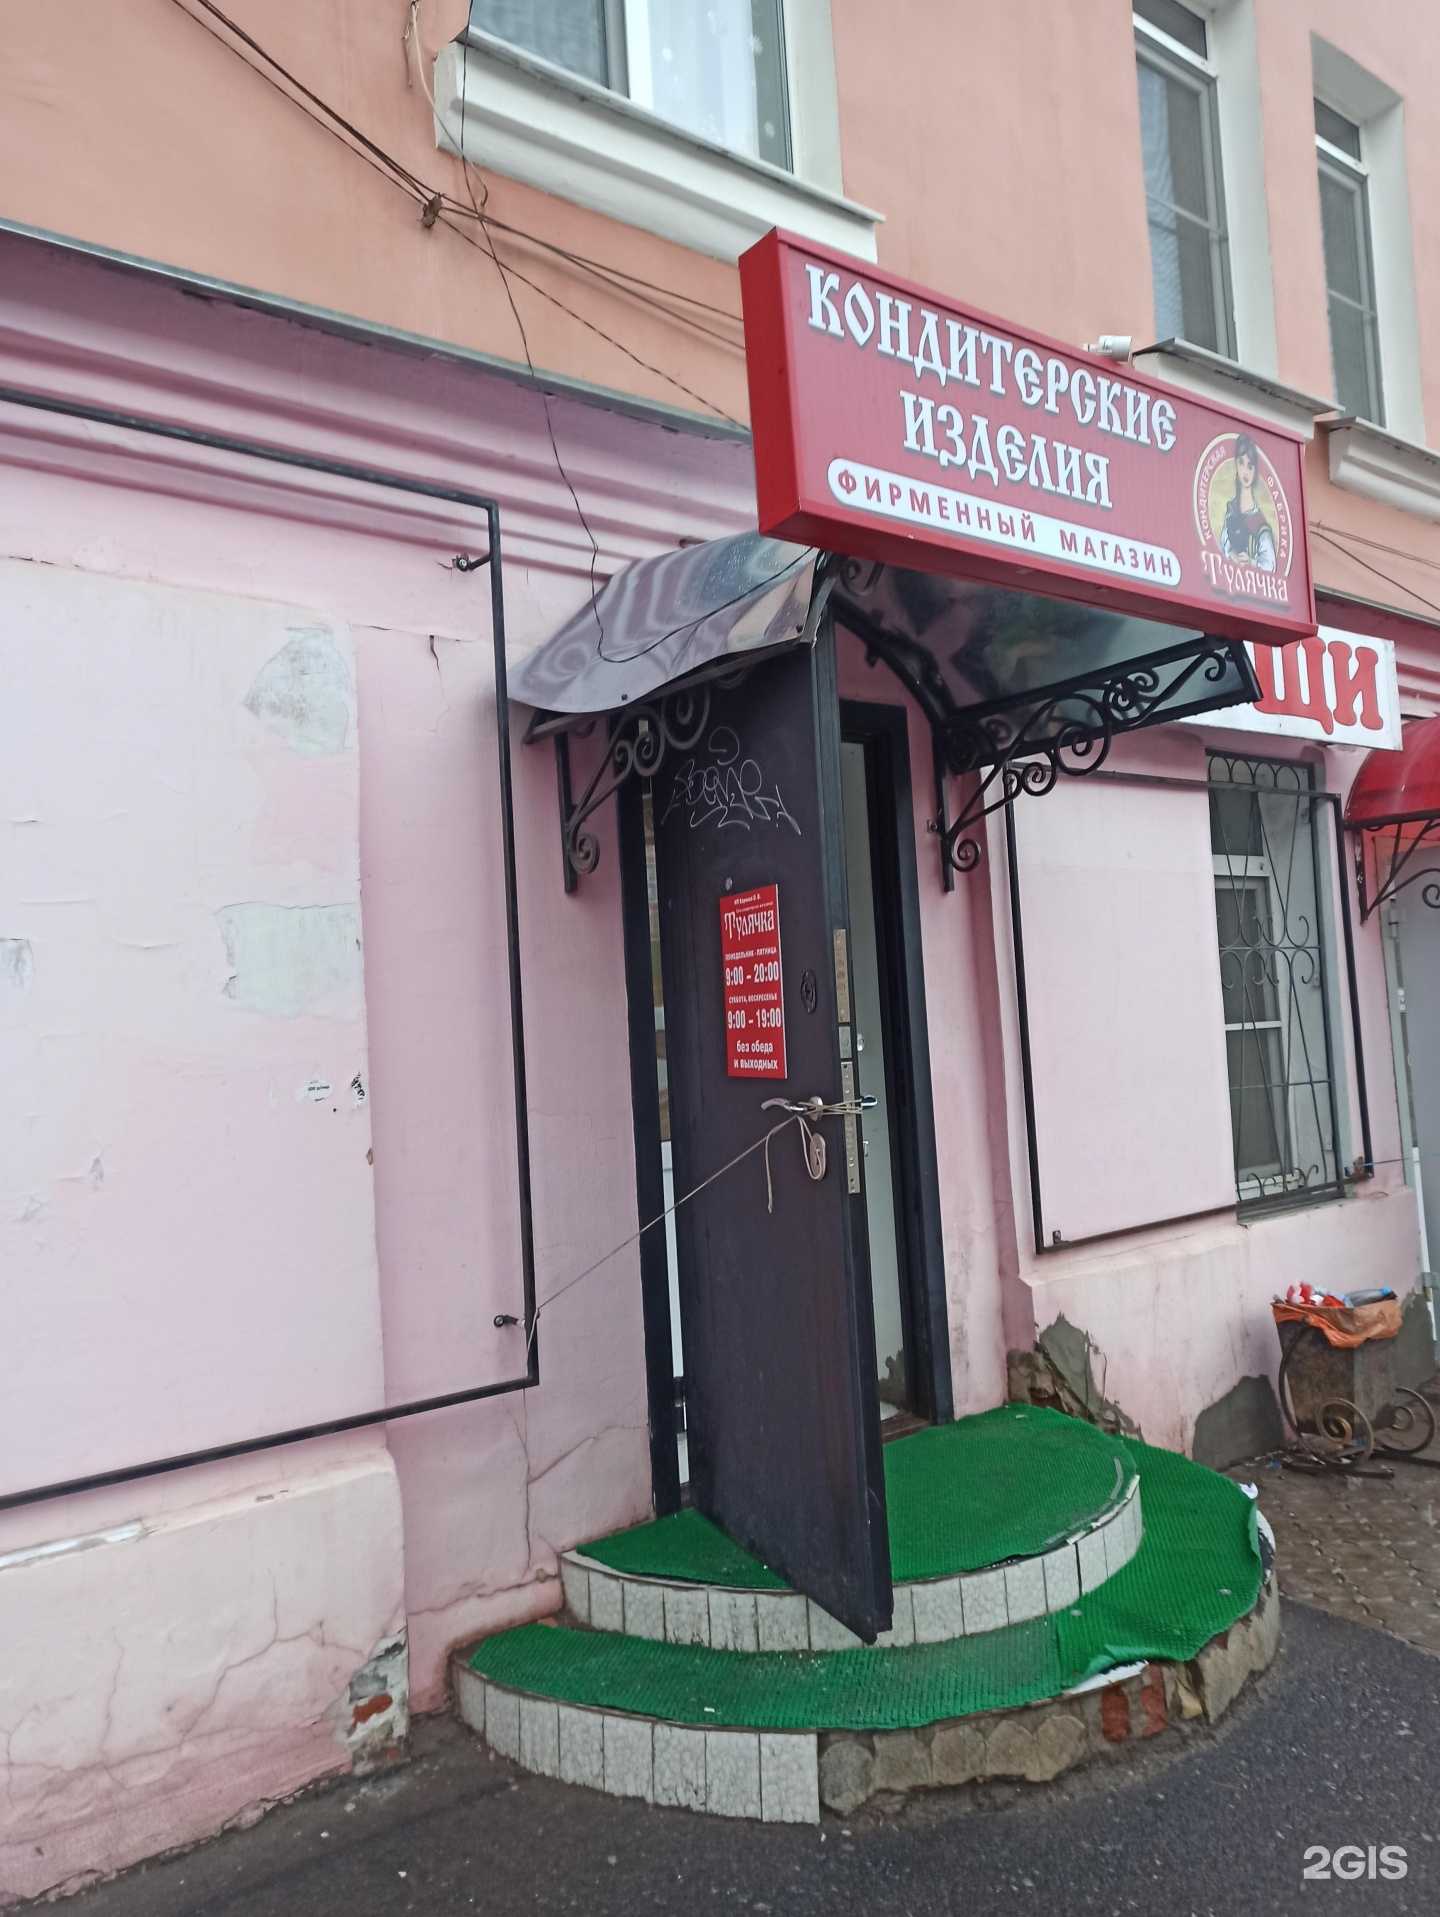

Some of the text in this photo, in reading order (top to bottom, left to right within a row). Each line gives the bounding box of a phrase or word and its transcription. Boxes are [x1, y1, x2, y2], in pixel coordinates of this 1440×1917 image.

[805, 263, 1178, 452] КОНДИТЕРСКИЕ
[899, 389, 1112, 509] ИЗДЕЛИЯ
[837, 468, 1173, 578] ФИРМЕННЫЙ МАГАЗИН
[1198, 446, 1226, 540] КОНДИТЕРСКАЯ
[1267, 475, 1287, 558] ФАБРИКА
[726, 965, 744, 986] 9:00
[754, 961, 779, 983] 20:00
[728, 1010, 747, 1029] 9:00
[756, 1007, 782, 1028] 19:00
[736, 1039, 774, 1054] без обеда
[740, 1058, 778, 1071] выходных
